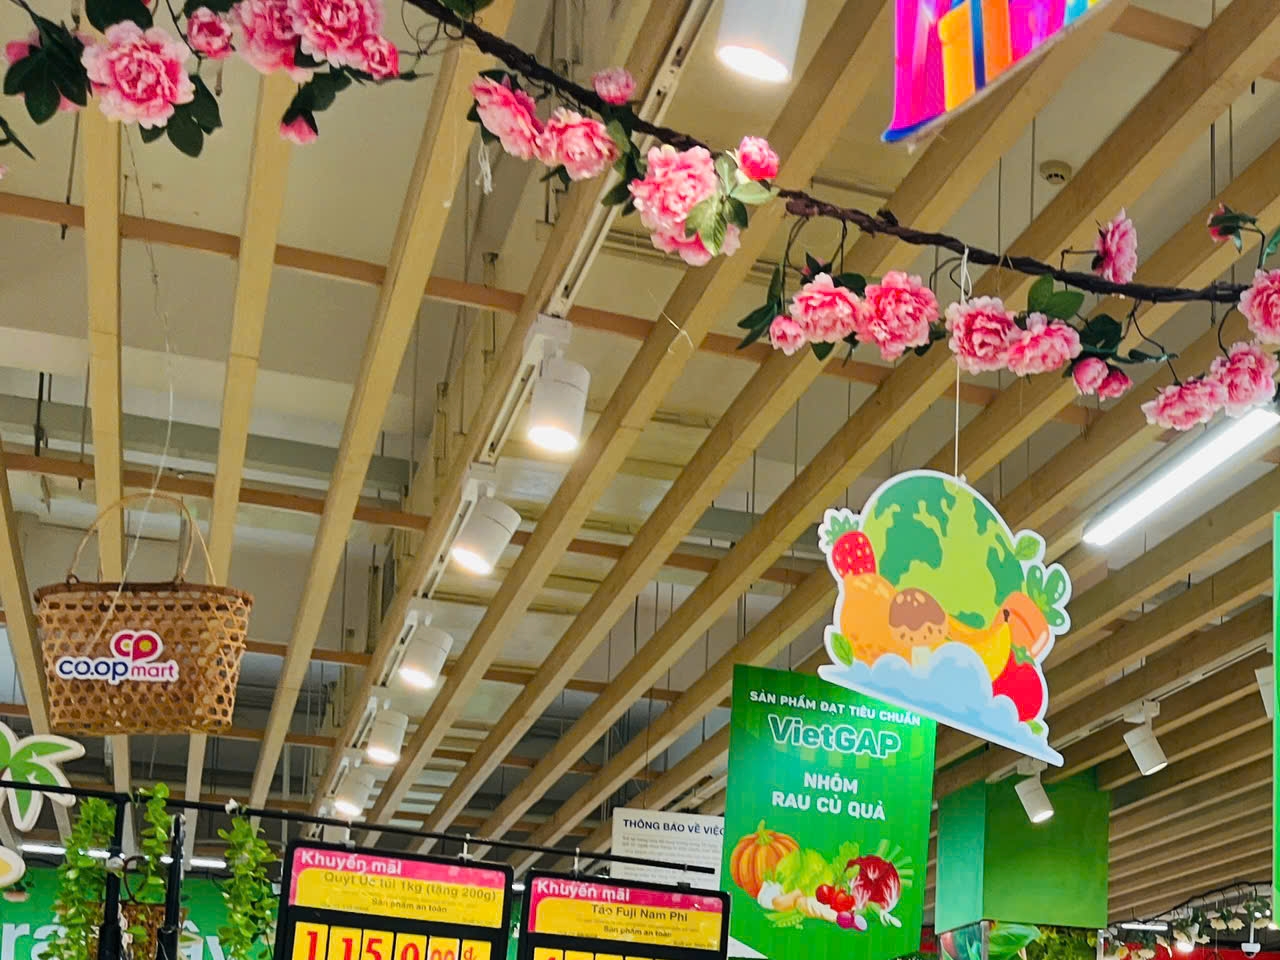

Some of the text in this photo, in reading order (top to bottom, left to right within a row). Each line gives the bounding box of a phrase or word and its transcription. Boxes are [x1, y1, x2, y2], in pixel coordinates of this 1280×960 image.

[750, 689, 921, 726] SẢN PHẨM ĐẠT TIÊU CHUẨN
[768, 714, 901, 758] VietGAP
[804, 772, 858, 794] NHÓM
[772, 791, 886, 821] RAU CỦ QUẢ
[623, 819, 660, 830] THÔNG
[663, 822, 685, 833] BÁO
[688, 823, 700, 833] VỀ
[301, 851, 367, 873] Khuyến
[400, 878, 423, 895] 1kg
[462, 885, 497, 902] 200g)
[537, 880, 597, 900] Khuyến
[616, 906, 637, 919] Fuji
[640, 909, 666, 921] Nam
